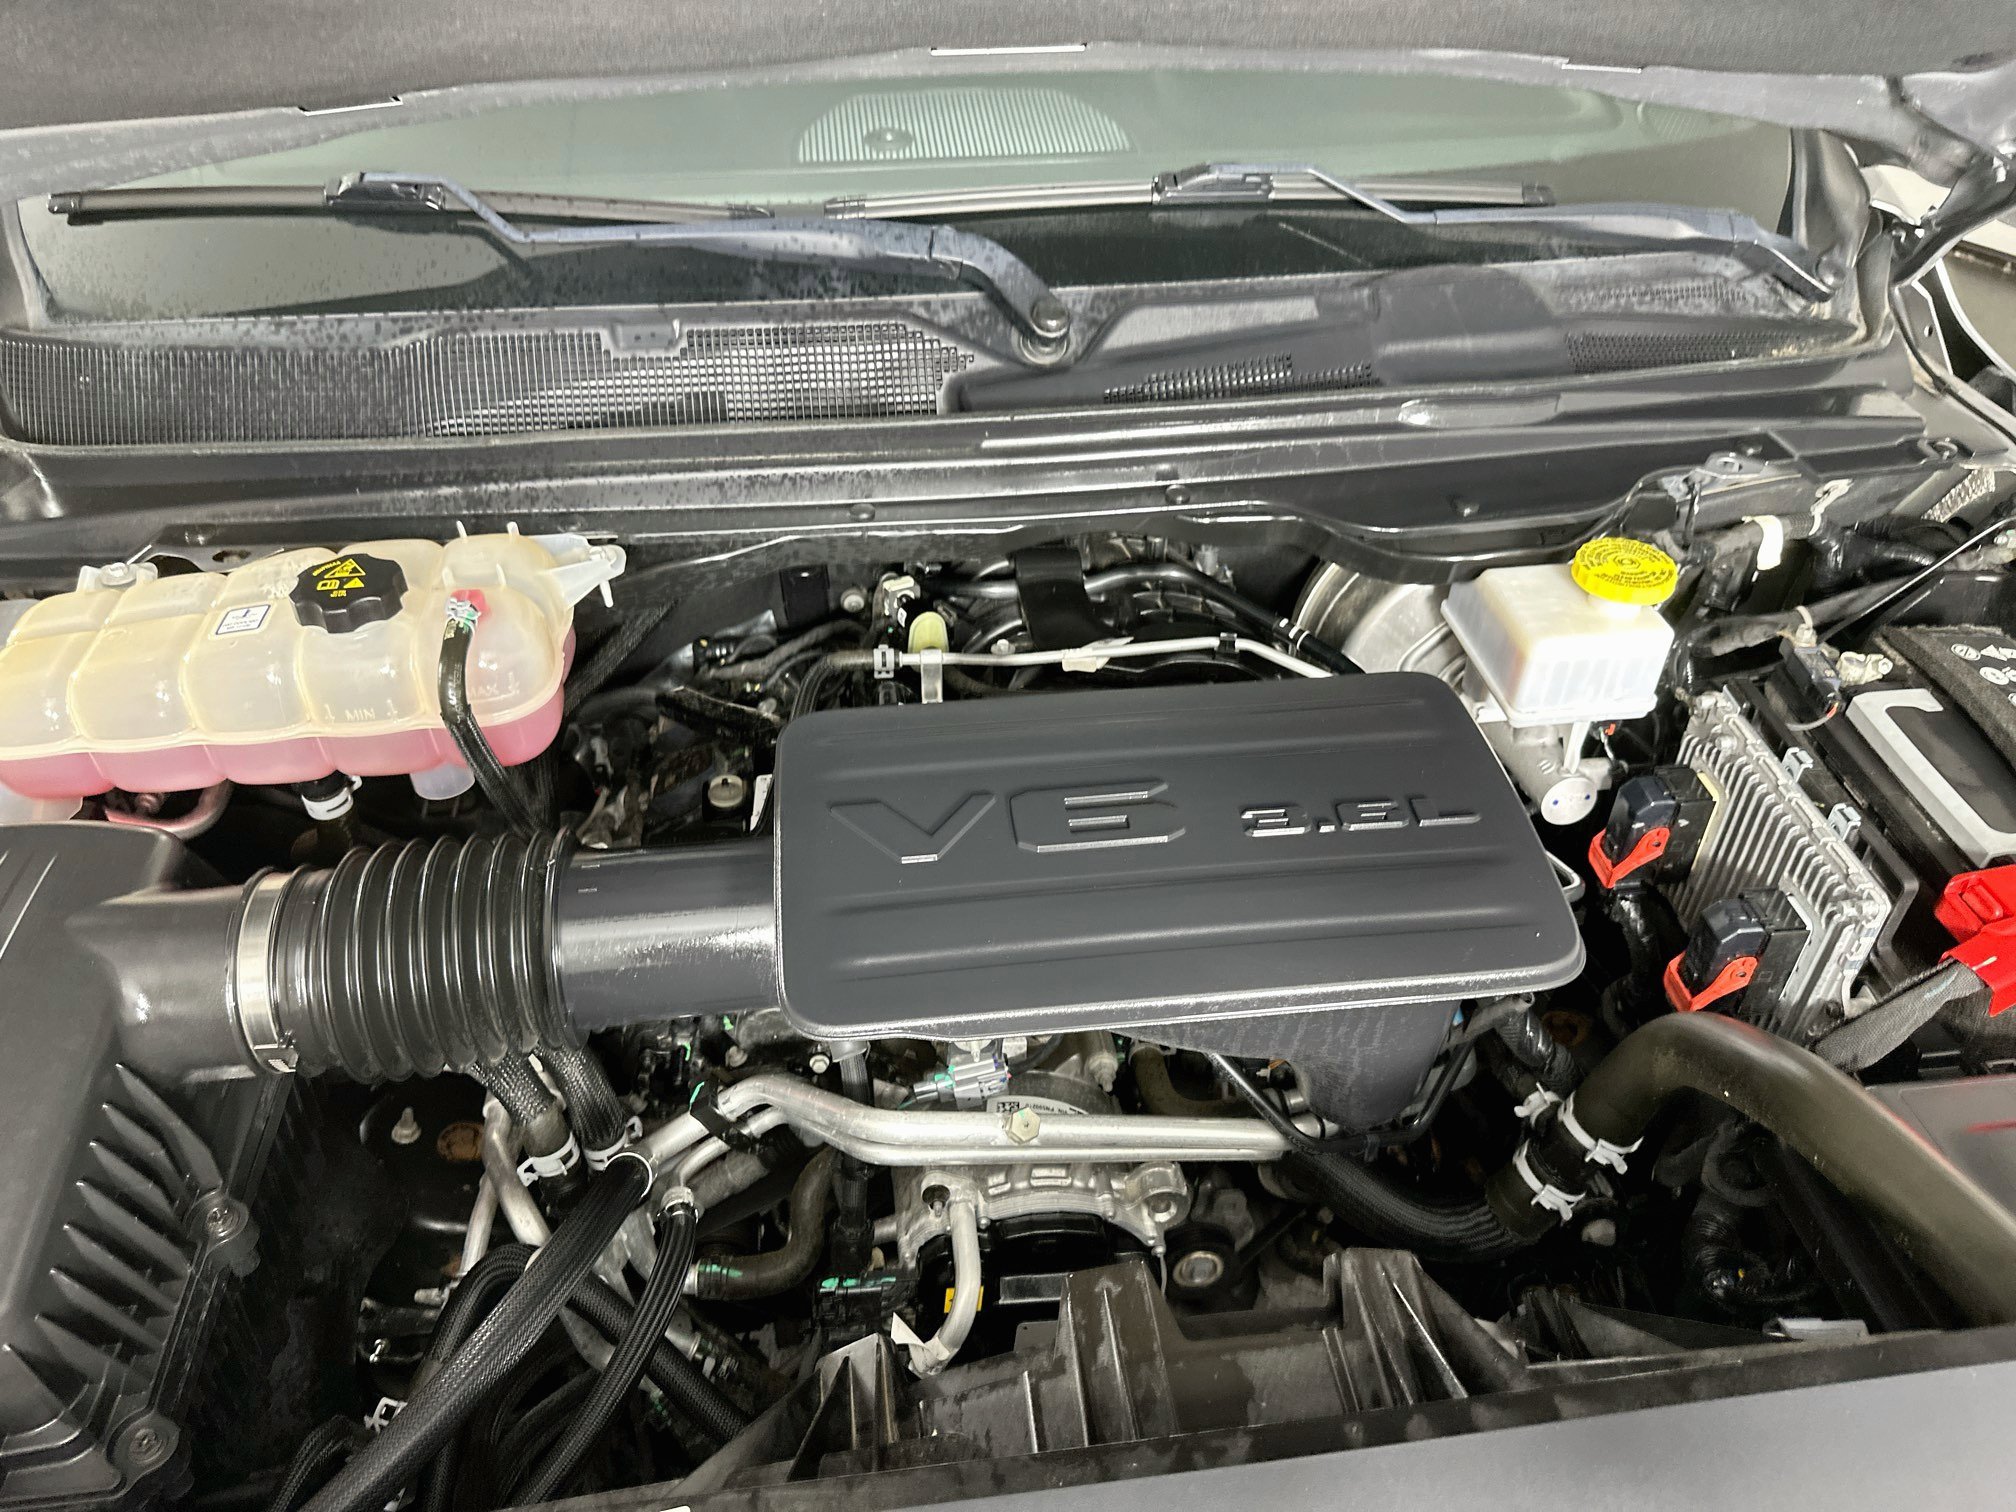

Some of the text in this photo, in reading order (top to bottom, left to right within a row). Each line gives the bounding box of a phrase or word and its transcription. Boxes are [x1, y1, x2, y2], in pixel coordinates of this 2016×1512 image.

[345, 708, 376, 721] MIN
[829, 778, 1482, 864] V6 3.6L
